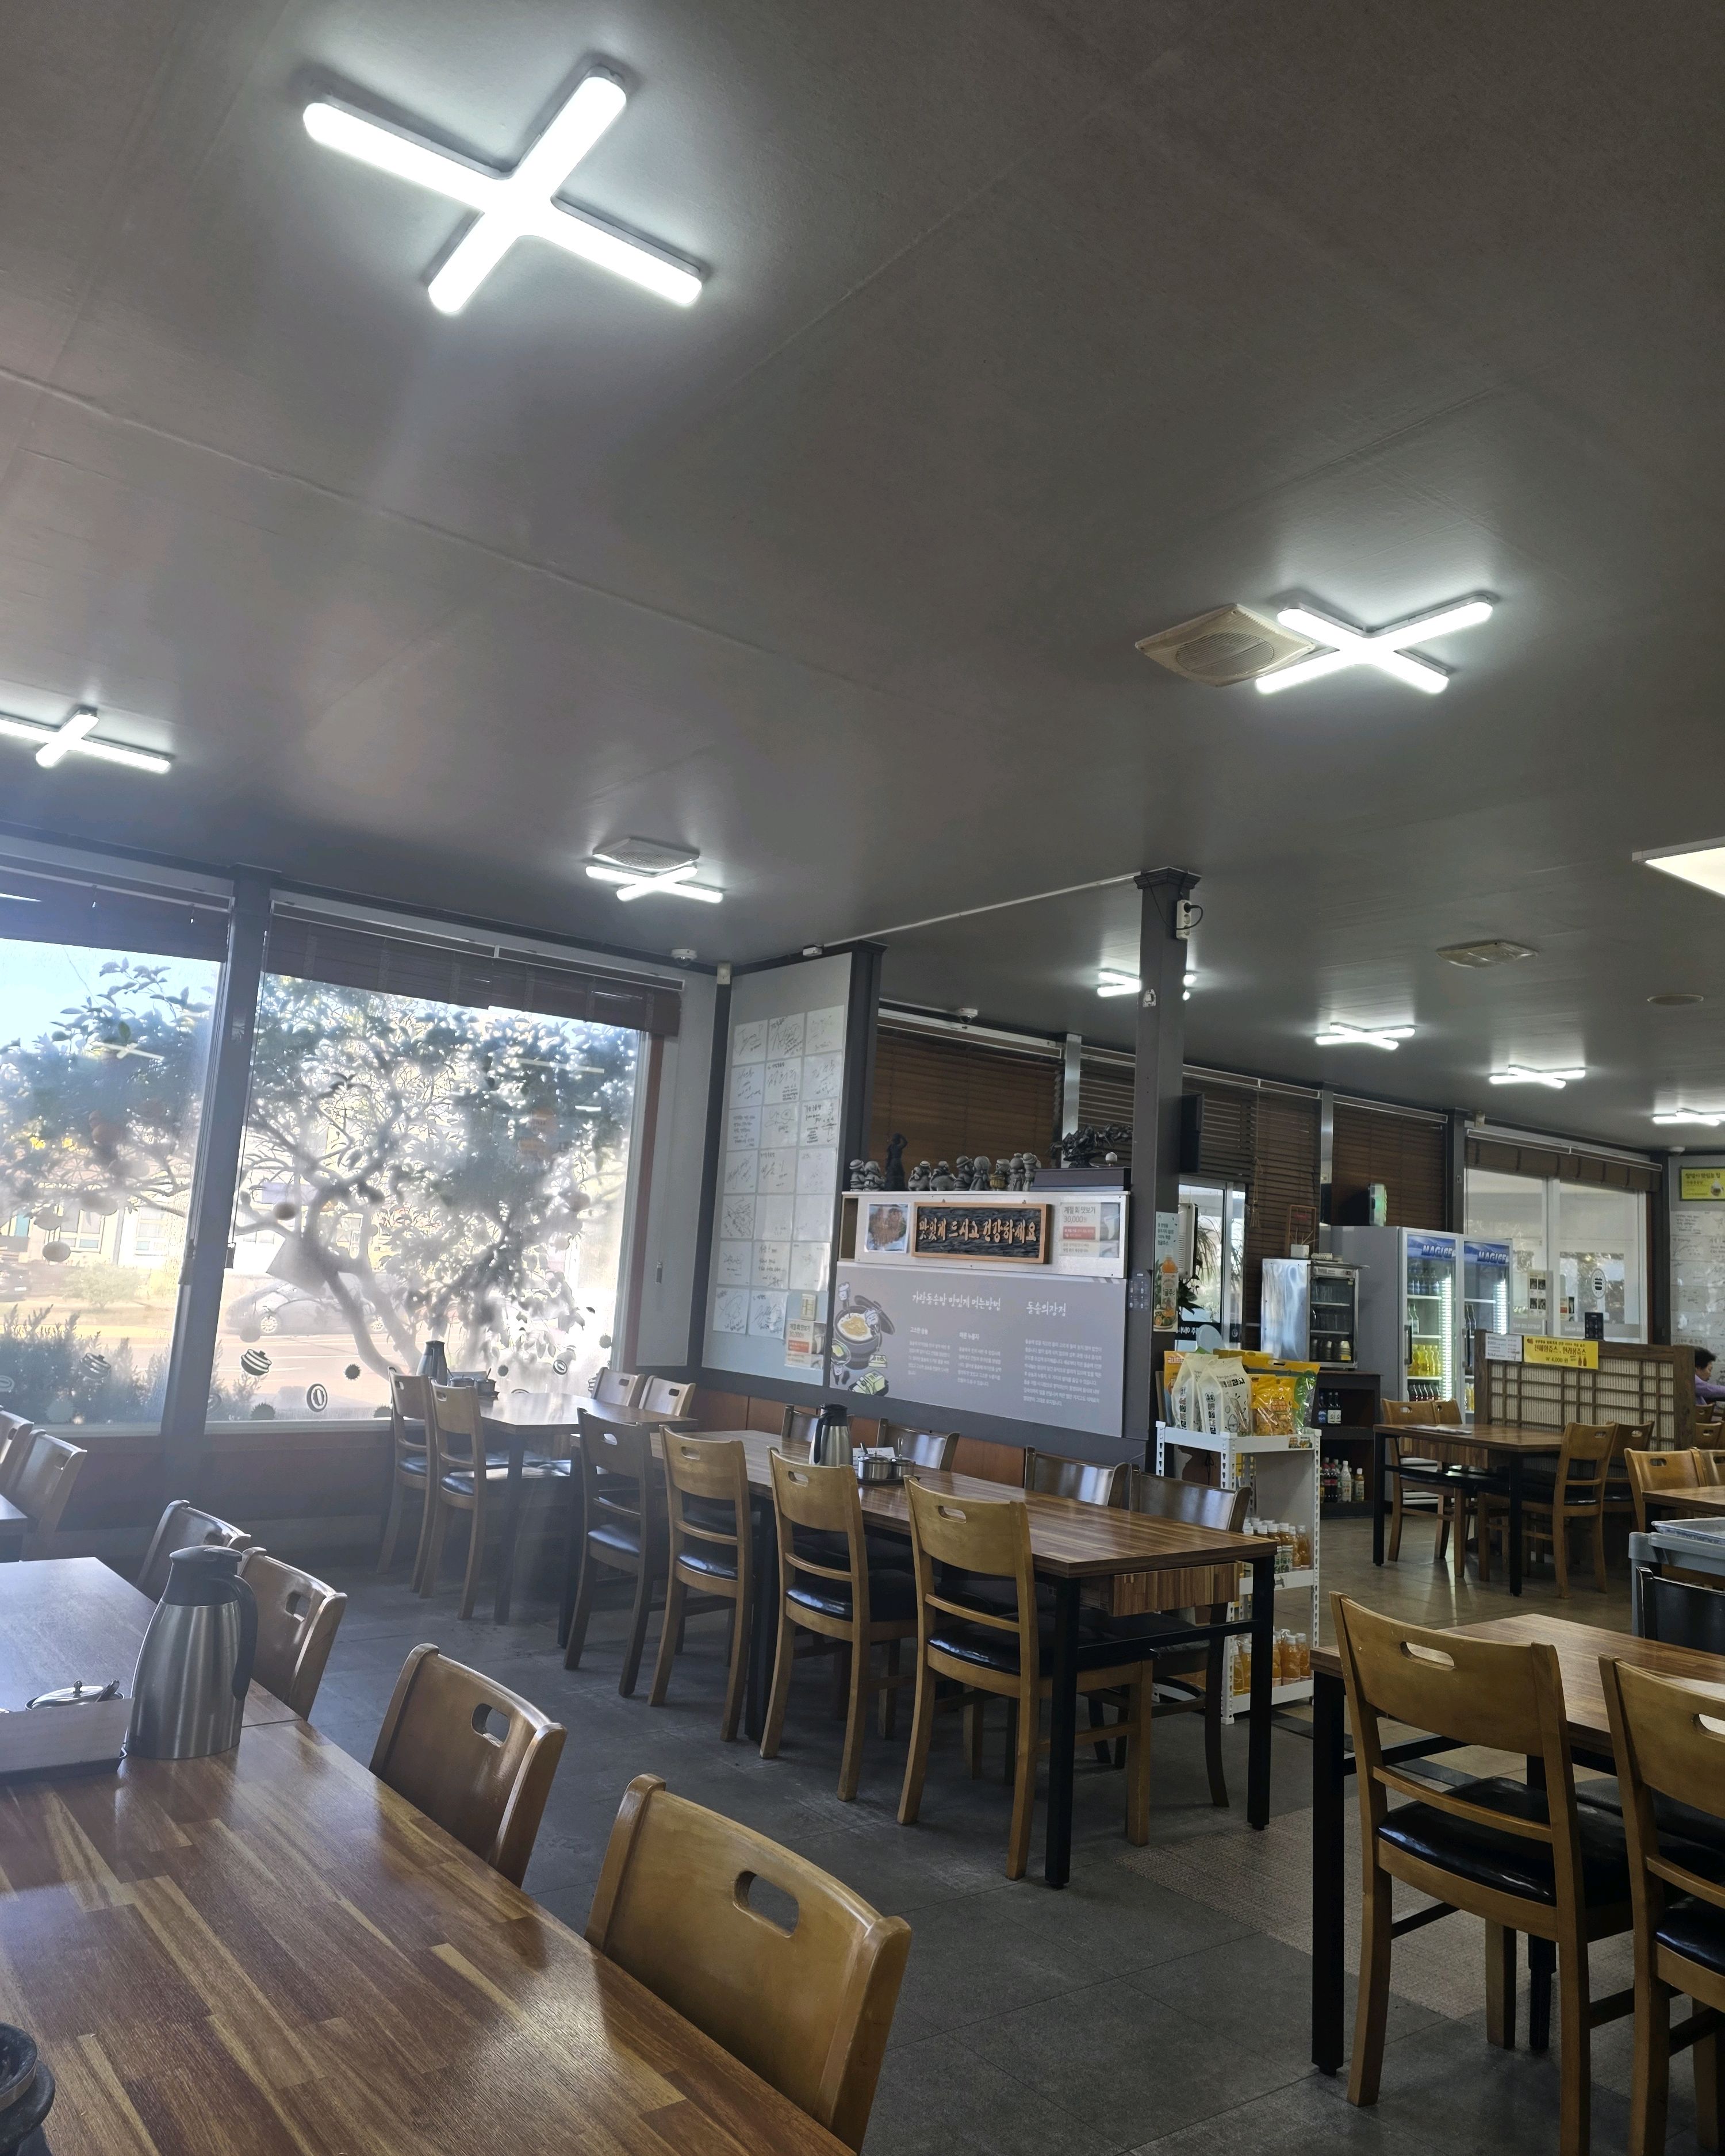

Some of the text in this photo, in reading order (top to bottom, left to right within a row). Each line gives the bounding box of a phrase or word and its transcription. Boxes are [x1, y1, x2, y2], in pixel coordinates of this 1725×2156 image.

[1080, 1206, 1096, 1214] 맛보기
[919, 1217, 946, 1241] 맛있게
[949, 1218, 980, 1241] 드시고
[983, 1218, 1037, 1245] 건강하세요
[911, 1291, 1001, 1311] 가람돌솥밥 맛있게 먹는방법
[1026, 1301, 1067, 1317] 돌솥의장점
